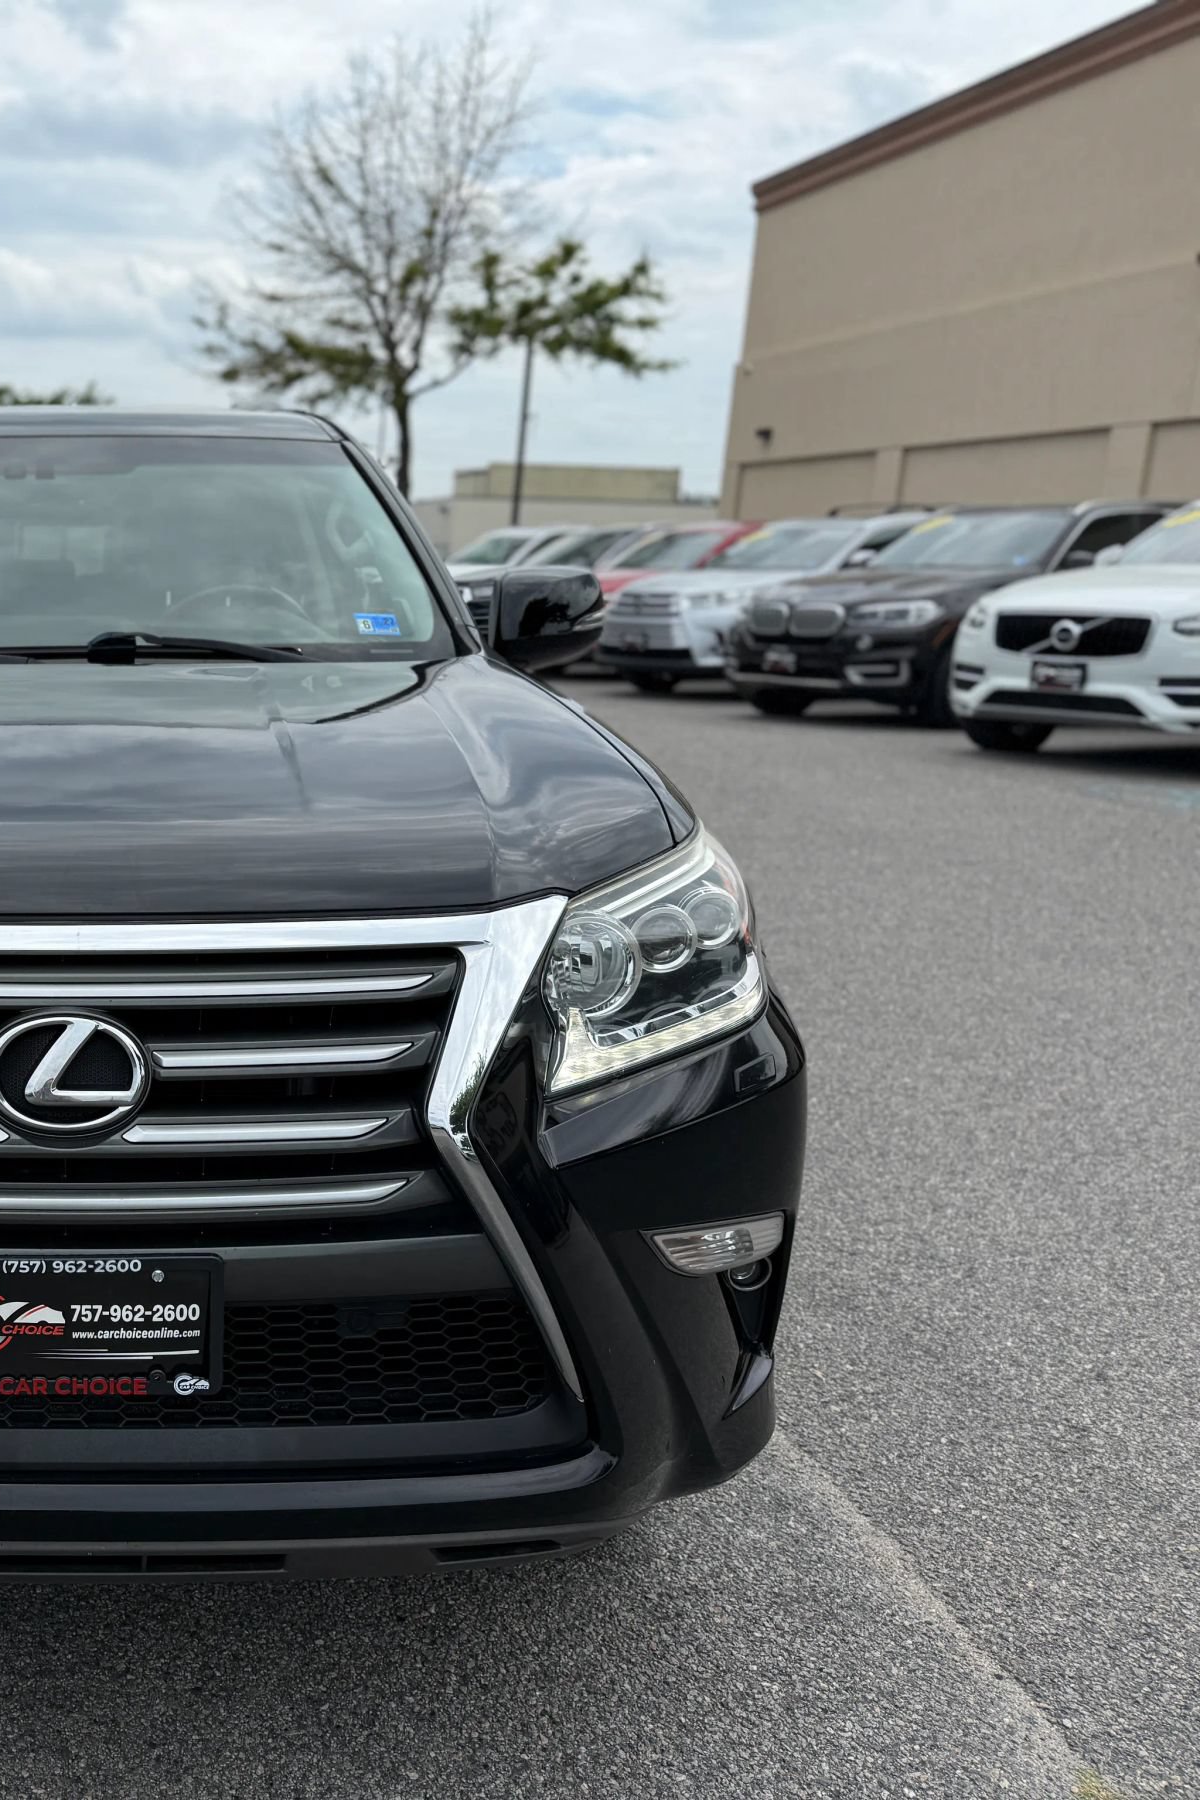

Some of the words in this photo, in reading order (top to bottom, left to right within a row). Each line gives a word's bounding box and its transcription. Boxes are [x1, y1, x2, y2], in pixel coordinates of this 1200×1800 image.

[2, 1260, 47, 1274] (757)
[52, 1259, 142, 1273] 962-2600
[70, 1303, 201, 1323] 757-962-2600
[1, 1325, 65, 1336] CHOICE
[72, 1327, 201, 1339] www.carchoiceonline.com
[0, 1376, 48, 1396] CAR
[54, 1376, 148, 1396] CHOICE
